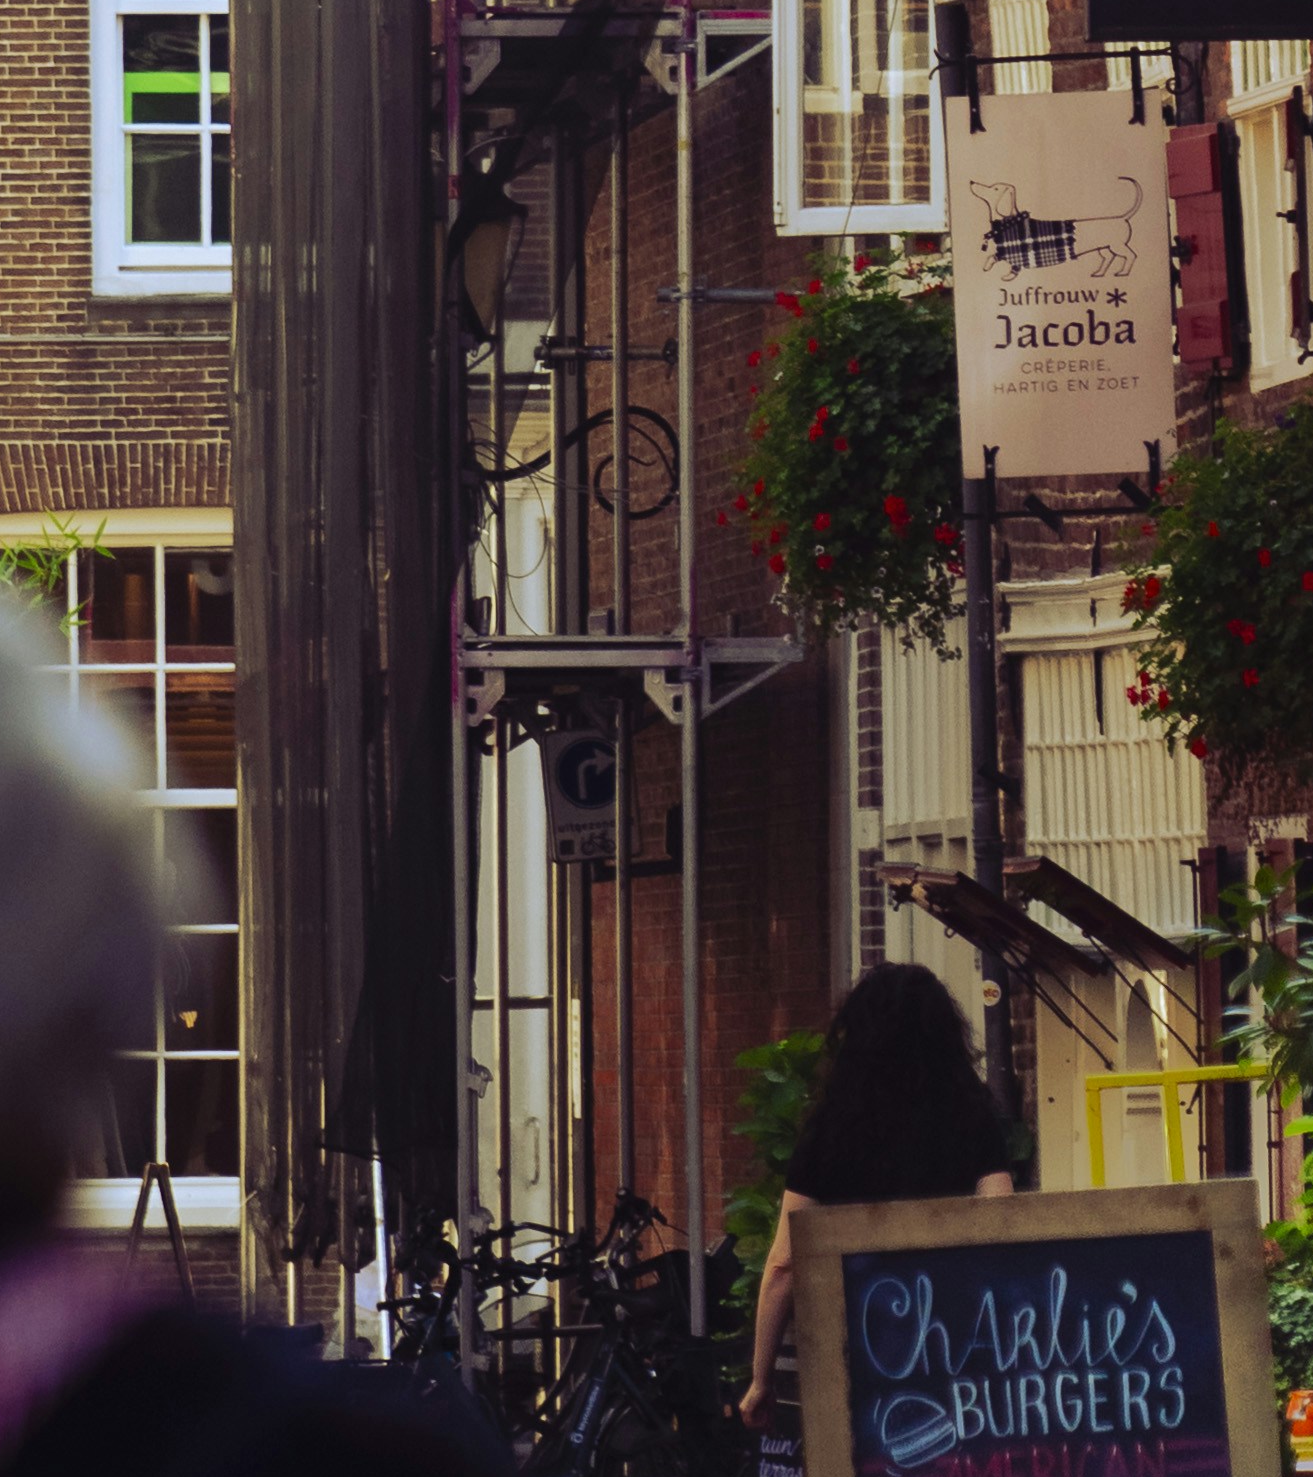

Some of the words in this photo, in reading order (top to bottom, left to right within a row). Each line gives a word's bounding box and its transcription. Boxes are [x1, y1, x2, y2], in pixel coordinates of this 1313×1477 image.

[998, 286, 1100, 306] Juffrouw
[994, 309, 1137, 350] Jacoba
[994, 381, 1059, 394] HARTIG
[1068, 379, 1089, 392] EN
[1097, 376, 1140, 391] ZOET
[952, 1365, 1186, 1440] BURGERS
